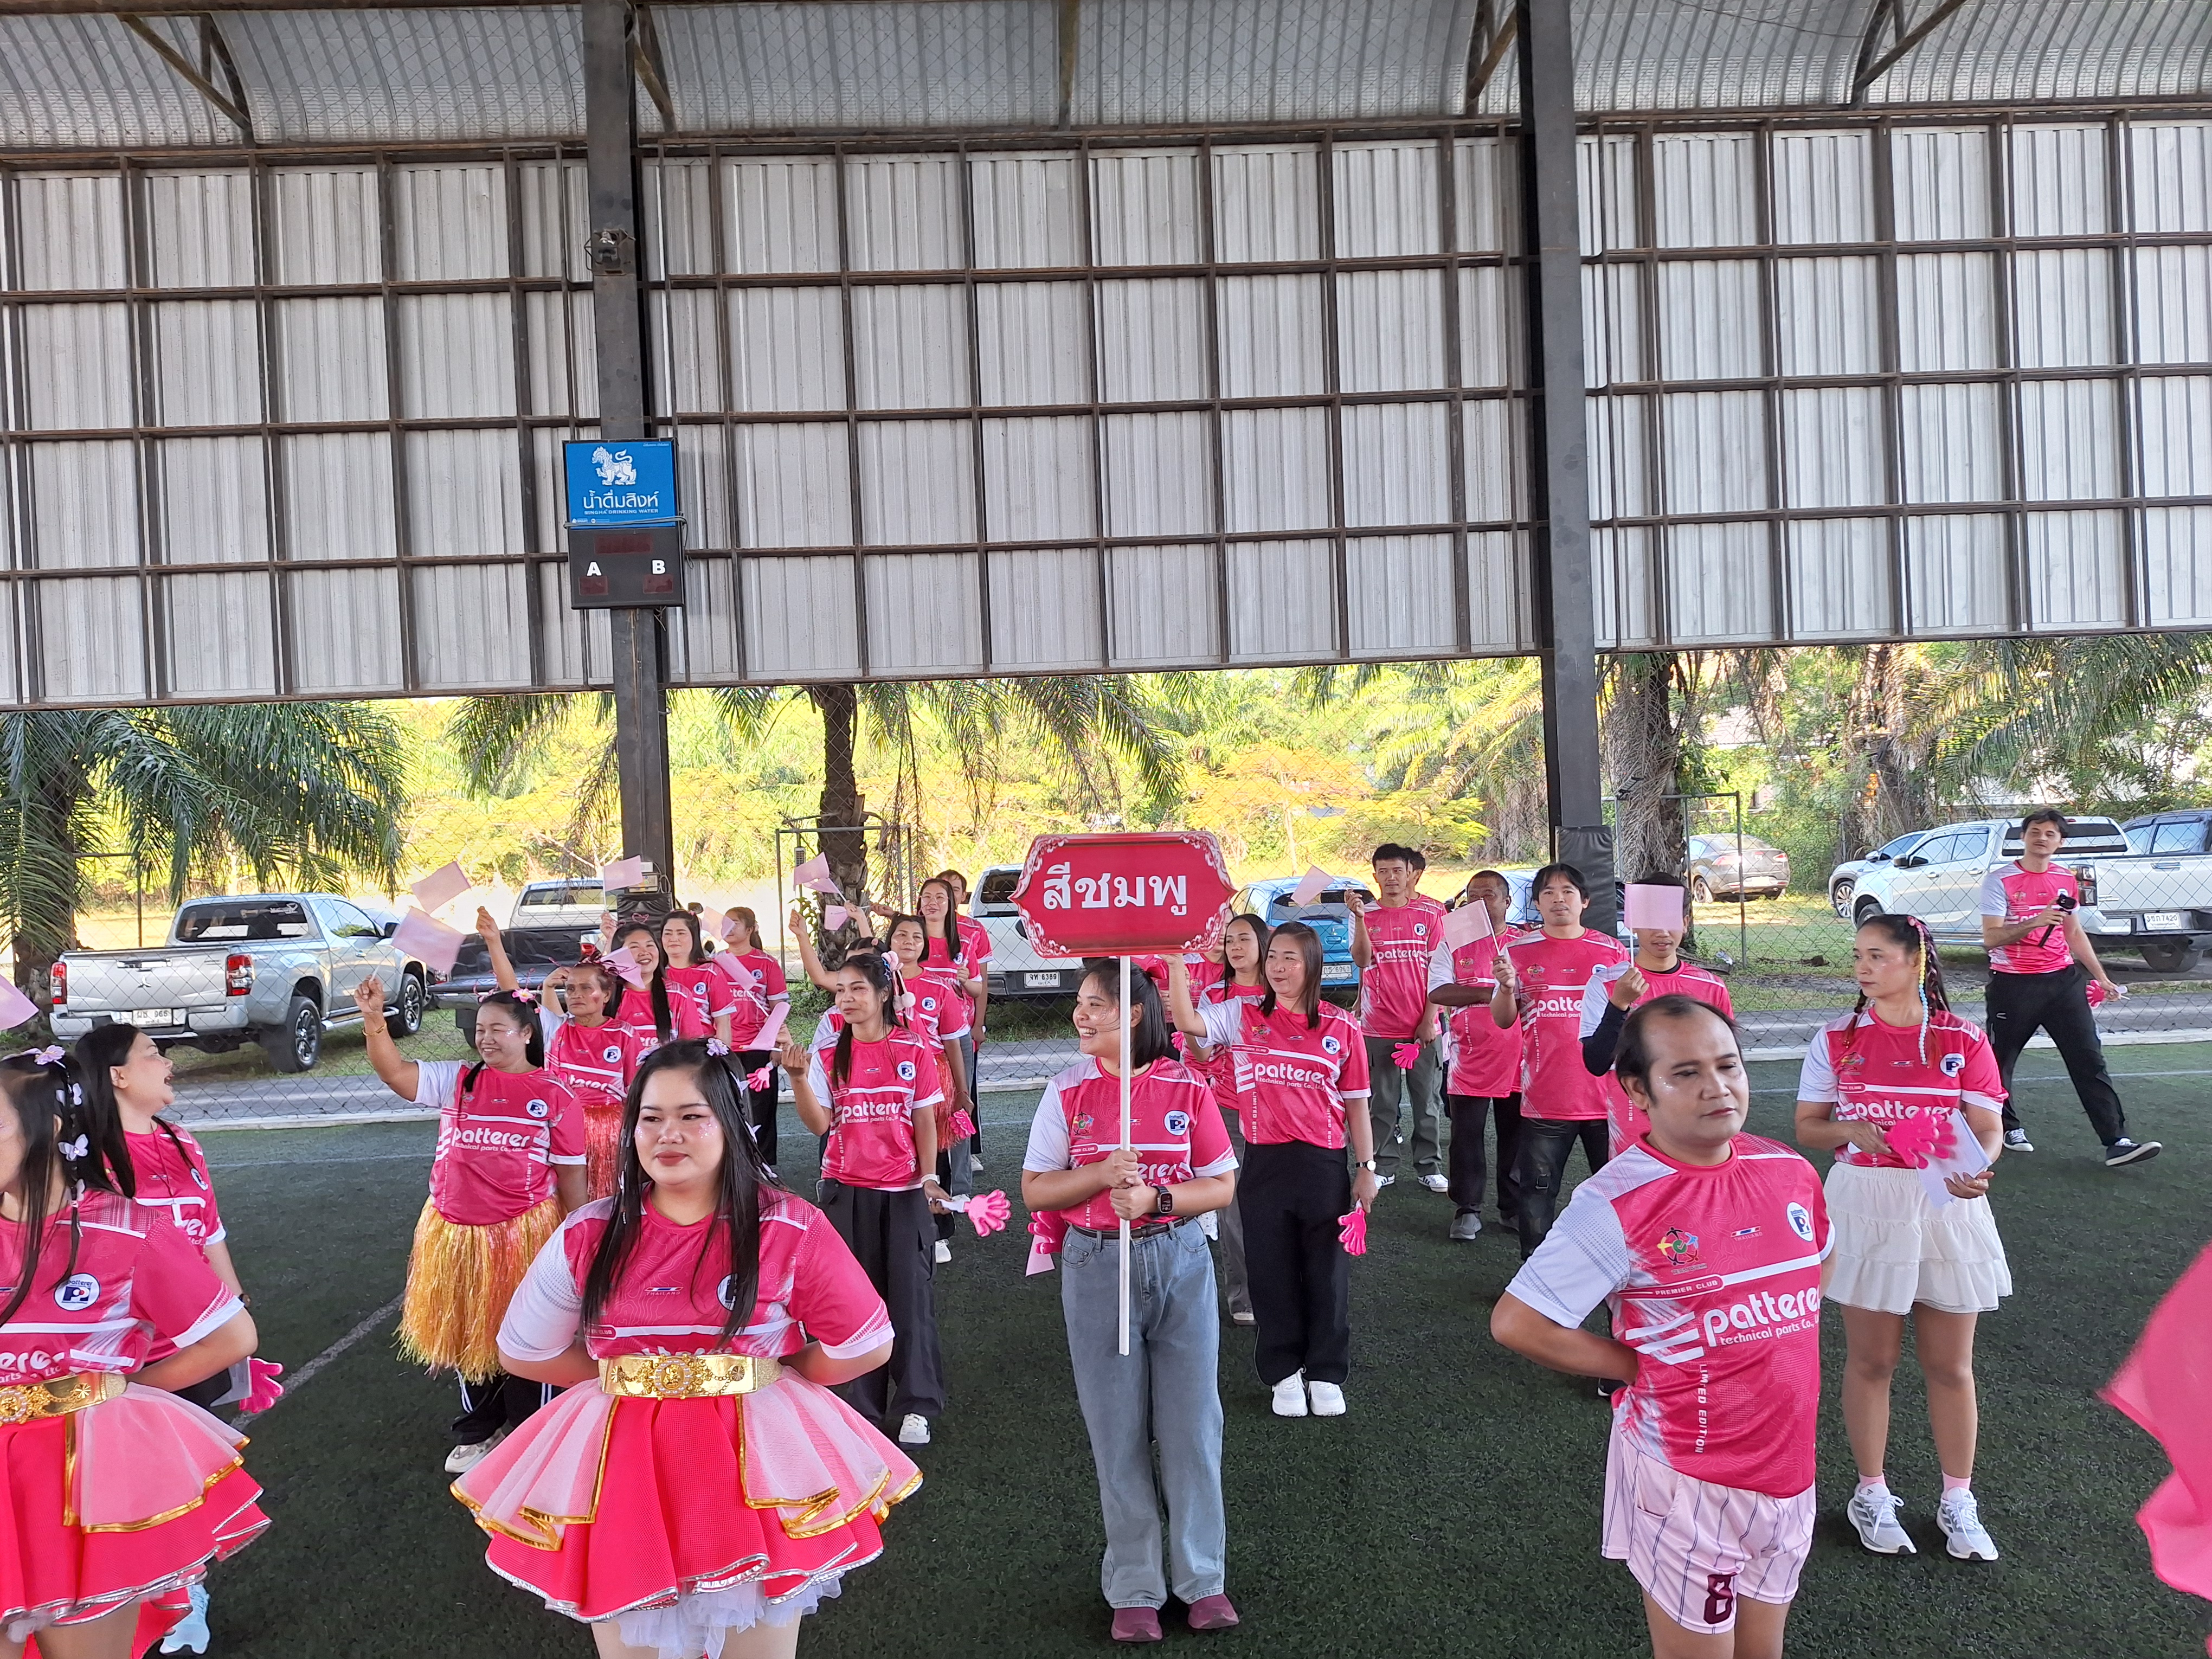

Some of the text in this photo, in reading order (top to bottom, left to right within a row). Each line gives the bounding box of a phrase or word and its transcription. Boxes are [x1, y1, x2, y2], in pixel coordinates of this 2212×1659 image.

[583, 489, 659, 509] น้ำดื่มสิงห์
[587, 562, 602, 576] A
[652, 560, 666, 574] B
[1043, 861, 1187, 916] สีชมพู
[1536, 996, 1582, 1017] patte
[451, 1127, 531, 1148] patterer
[1138, 1163, 1177, 1180] erer
[1733, 1231, 1763, 1242] THAILAND
[1655, 1280, 1718, 1296] PREMIER CLUB
[1720, 1327, 1773, 1346] technical
[1776, 1323, 1799, 1339] parts
[1801, 1319, 1815, 1329] Co.,
[0, 1350, 65, 1373] erer
[0, 1372, 22, 1382] arts
[1694, 1364, 1708, 1454] LIMED EDITION
[1703, 1572, 1738, 1624] 8
